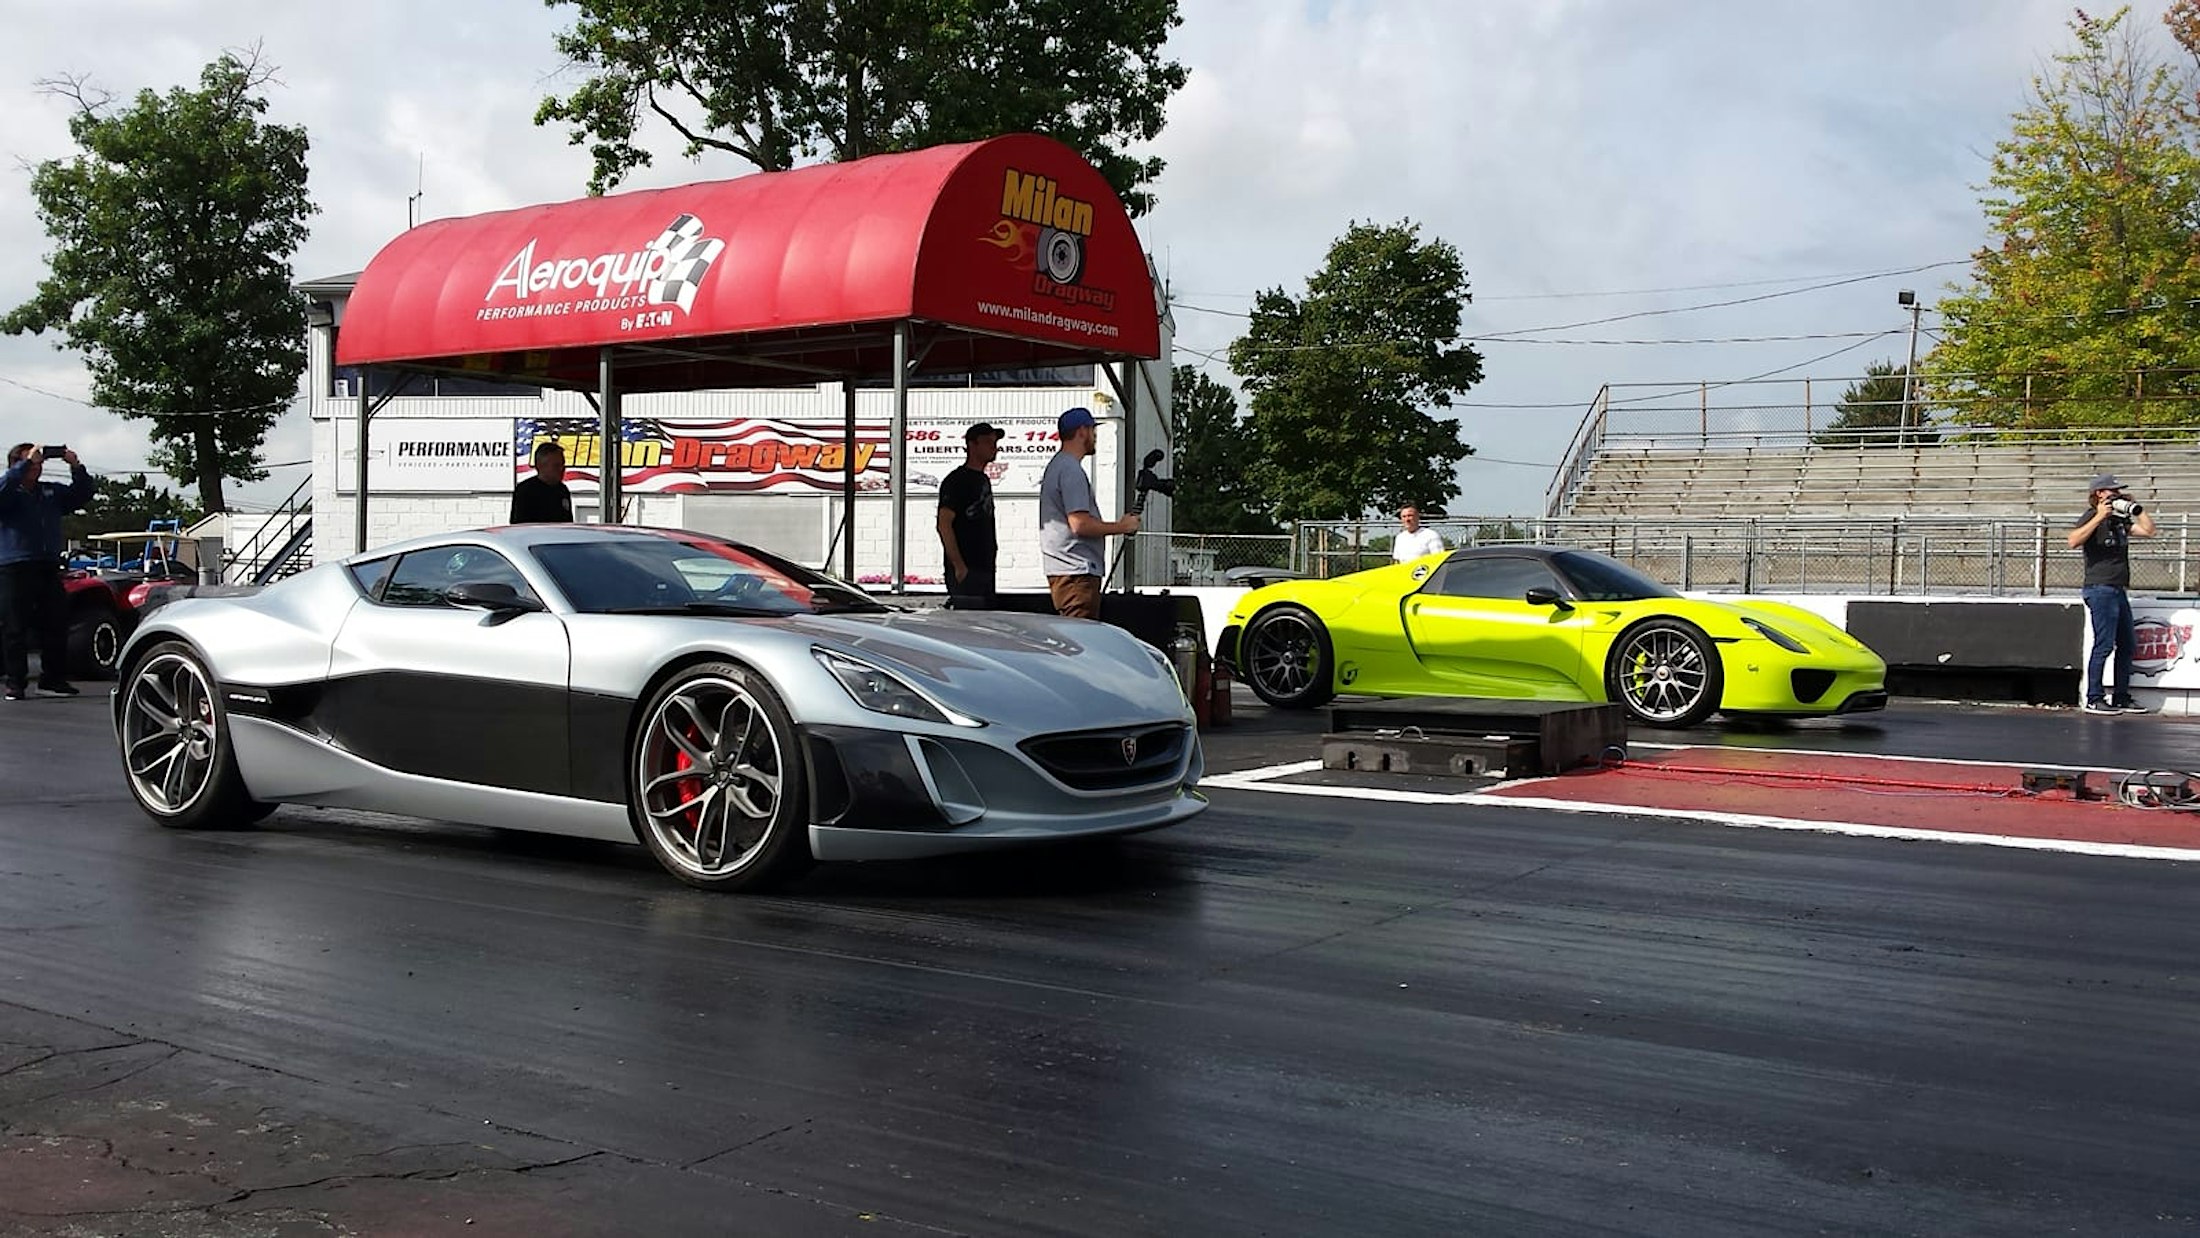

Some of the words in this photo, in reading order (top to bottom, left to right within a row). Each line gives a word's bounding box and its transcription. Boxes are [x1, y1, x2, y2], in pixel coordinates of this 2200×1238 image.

[1001, 168, 1095, 237] Milan
[485, 236, 672, 302] Aeroquip
[477, 302, 570, 321] PERFORMANCE
[575, 295, 647, 313] PRODUCTS
[1033, 271, 1116, 312] Dragway
[621, 318, 634, 330] By
[977, 301, 1119, 337] www.milandragway.com
[398, 441, 511, 457] PERFORMANCE
[1025, 431, 1060, 441] 114
[671, 436, 877, 473] Dragway
